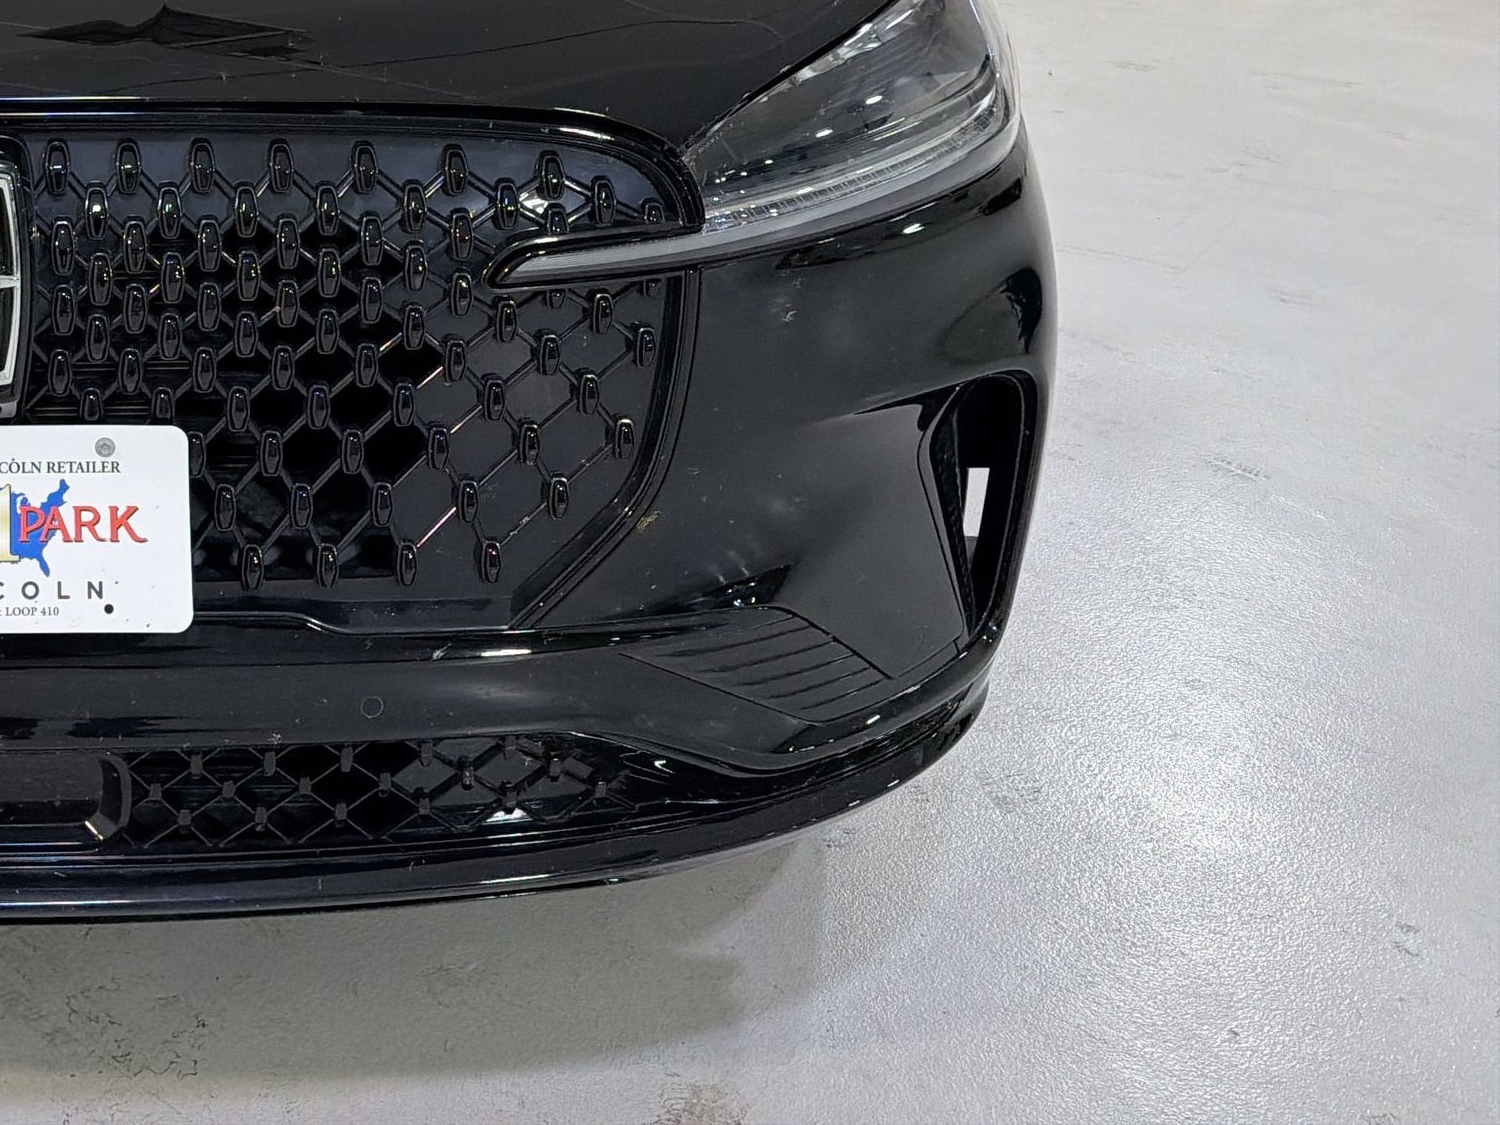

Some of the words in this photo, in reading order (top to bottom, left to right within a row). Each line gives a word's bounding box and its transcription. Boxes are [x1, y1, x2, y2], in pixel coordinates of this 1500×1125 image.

[46, 460, 122, 474] RETAILER
[19, 505, 149, 544] PARK
[5, 606, 37, 617] LOOP
[40, 606, 60, 616] 410
